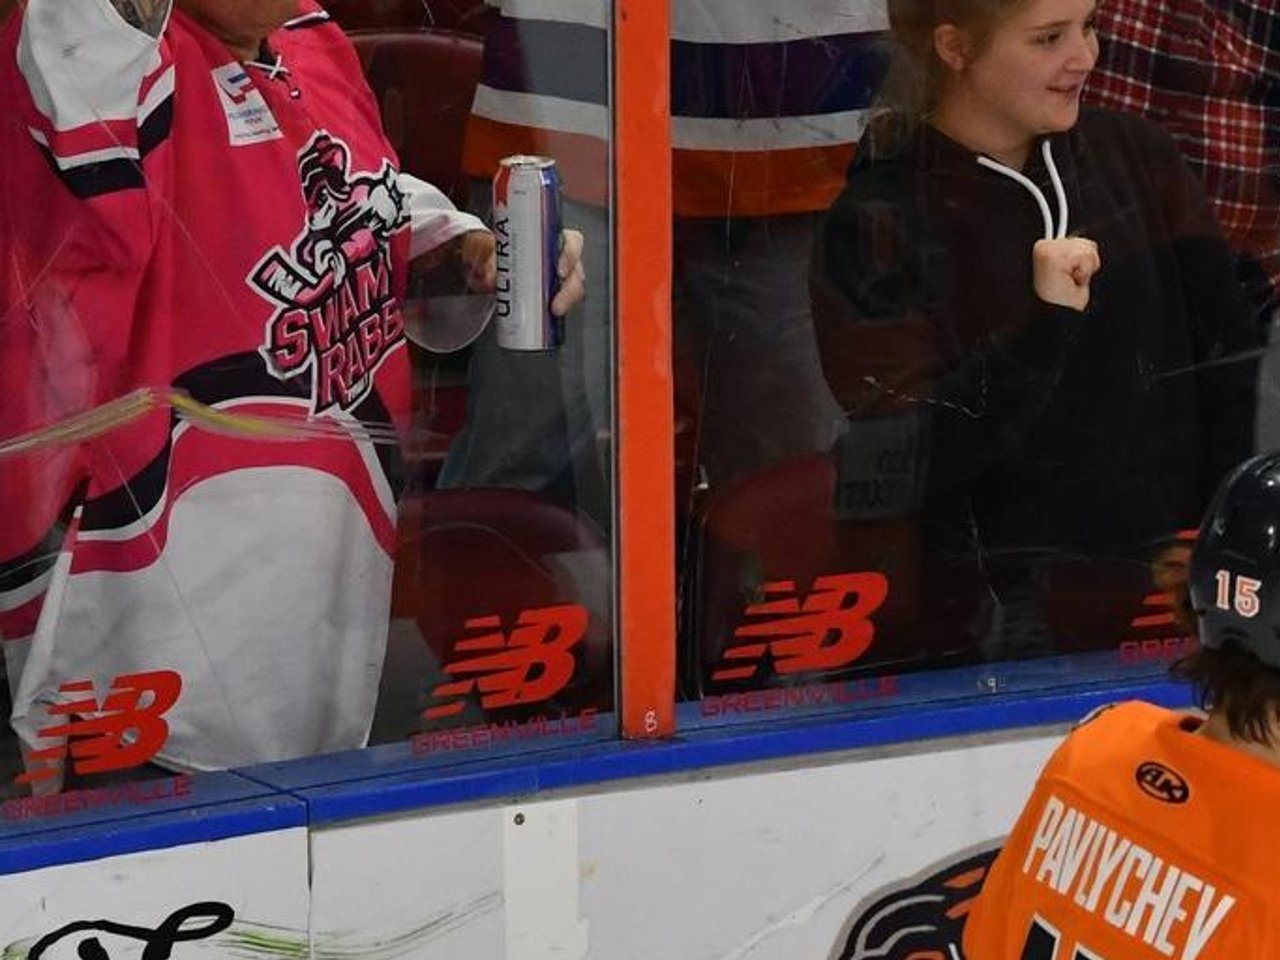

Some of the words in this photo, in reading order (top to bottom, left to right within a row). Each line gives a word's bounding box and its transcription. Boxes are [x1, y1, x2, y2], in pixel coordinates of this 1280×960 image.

[272, 254, 393, 370] SWAM
[496, 217, 511, 318] ULTRA
[1215, 569, 1262, 618] 15
